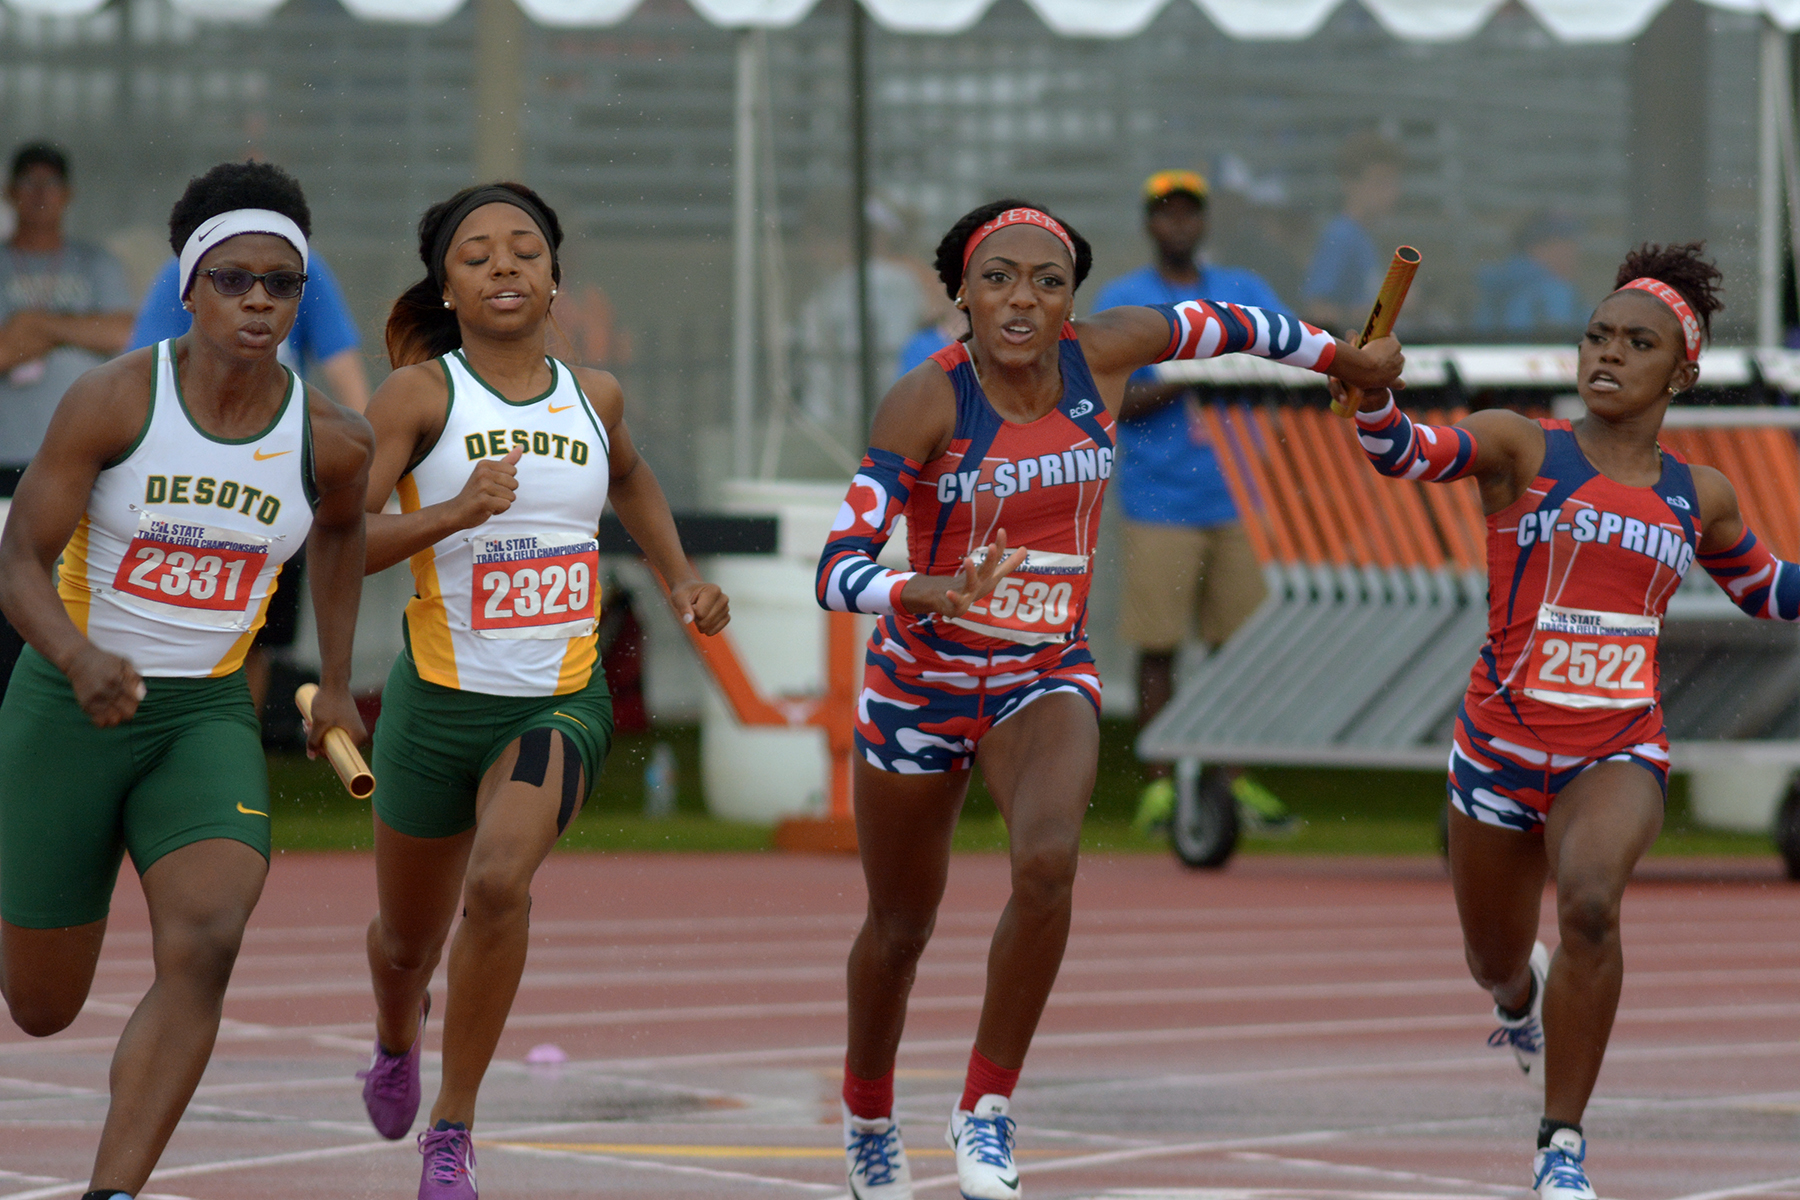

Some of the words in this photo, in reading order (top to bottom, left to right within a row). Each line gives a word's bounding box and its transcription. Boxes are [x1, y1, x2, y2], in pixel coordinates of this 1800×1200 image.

[1069, 404, 1087, 418] PCS
[464, 429, 589, 467] DESOTO
[145, 475, 282, 526] DESOTO
[138, 529, 170, 544] TRACK
[175, 536, 200, 548] FIELD
[200, 539, 268, 554] CHAMPIONSHIPS
[171, 524, 205, 539] STATE
[476, 551, 505, 564] TRACK
[513, 549, 536, 561] FIELD
[537, 541, 597, 558] CHAMPIONSHIPS
[506, 537, 537, 551] STATE
[127, 546, 247, 601] 2331
[482, 561, 590, 619] 2329
[1540, 621, 1568, 633] TRACK
[1576, 624, 1598, 635] FIELD
[1570, 613, 1601, 626] STATE
[1538, 638, 1647, 689] 2522
